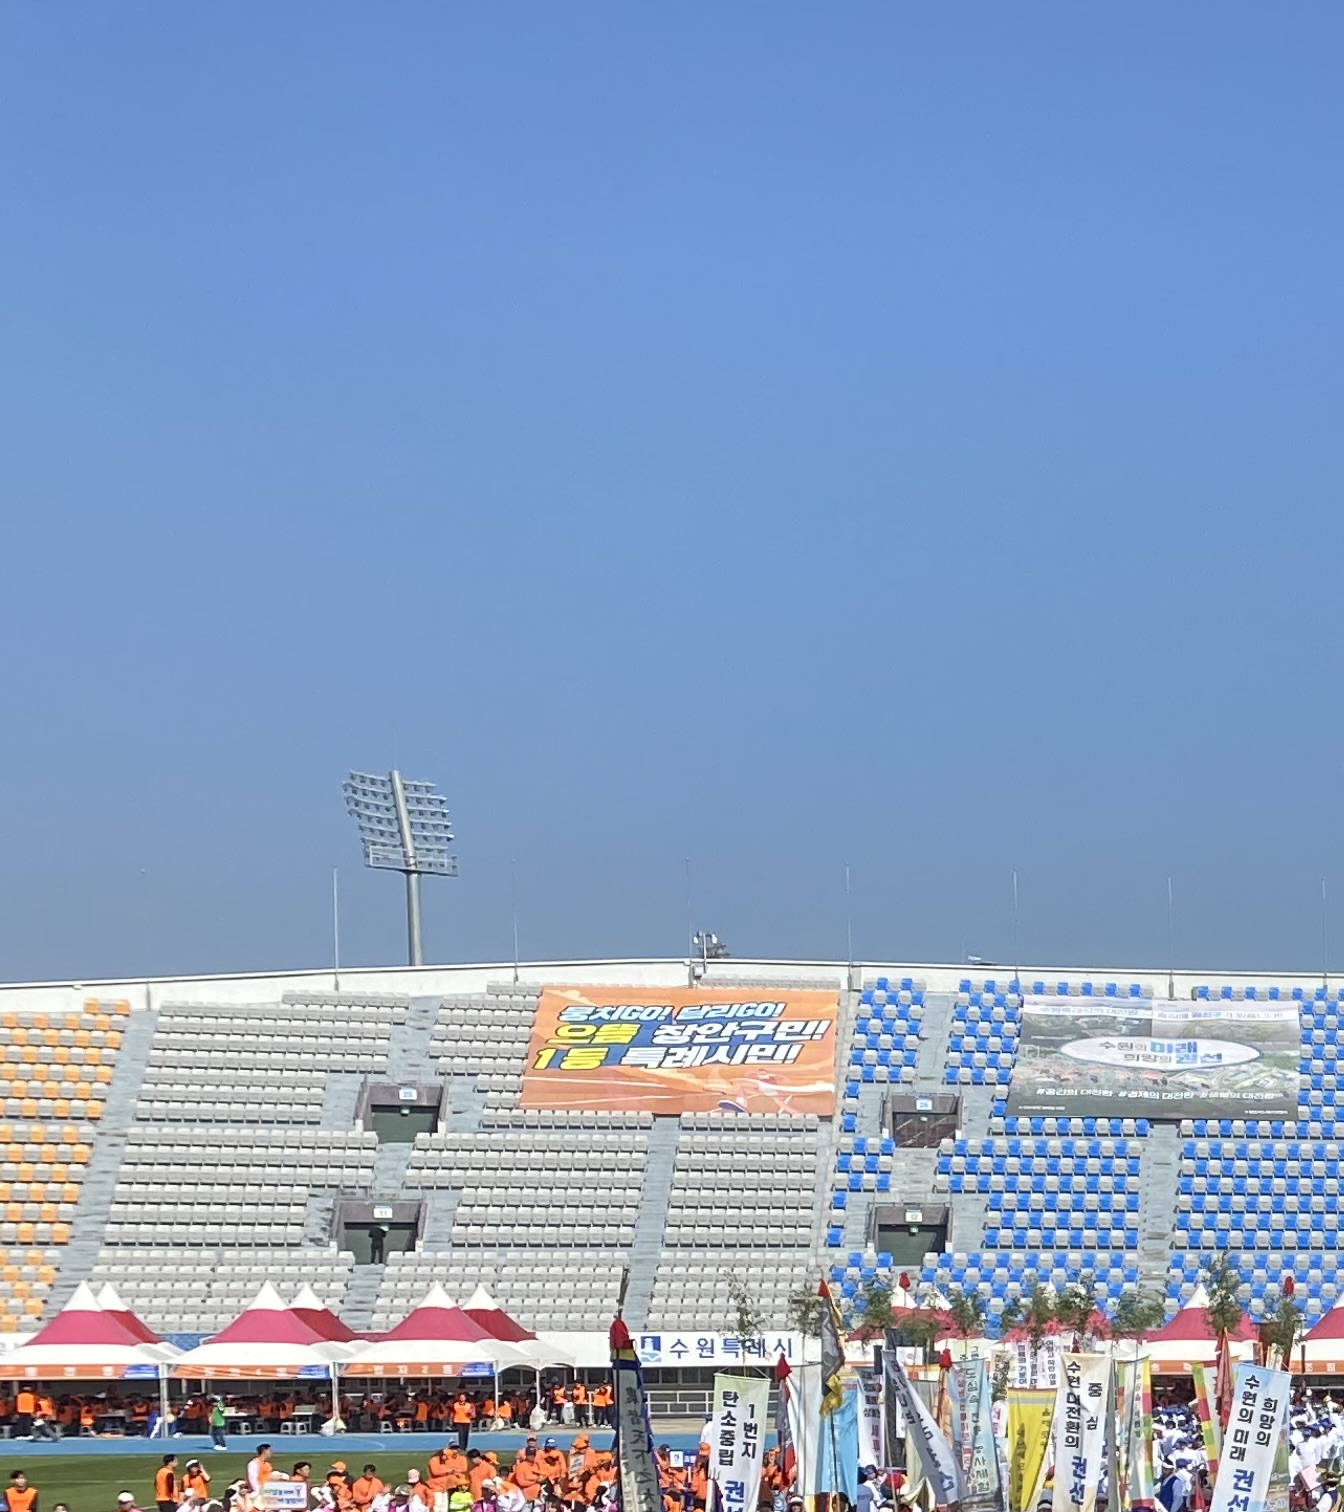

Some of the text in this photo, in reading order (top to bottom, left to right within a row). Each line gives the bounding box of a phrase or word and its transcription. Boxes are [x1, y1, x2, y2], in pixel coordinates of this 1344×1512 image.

[532, 1046, 611, 1071] 1등
[1150, 1040, 1198, 1054] 미래
[669, 1337, 793, 1359] 수원특례시
[1066, 1360, 1082, 1389] 수원
[717, 1390, 739, 1467] 탄소중립
[740, 1402, 759, 1460] 1번지
[1086, 1382, 1103, 1431] 중심
[1229, 1374, 1261, 1463] 수원의 미래
[1255, 1397, 1279, 1448] 희망의
[1069, 1455, 1088, 1506] 권선
